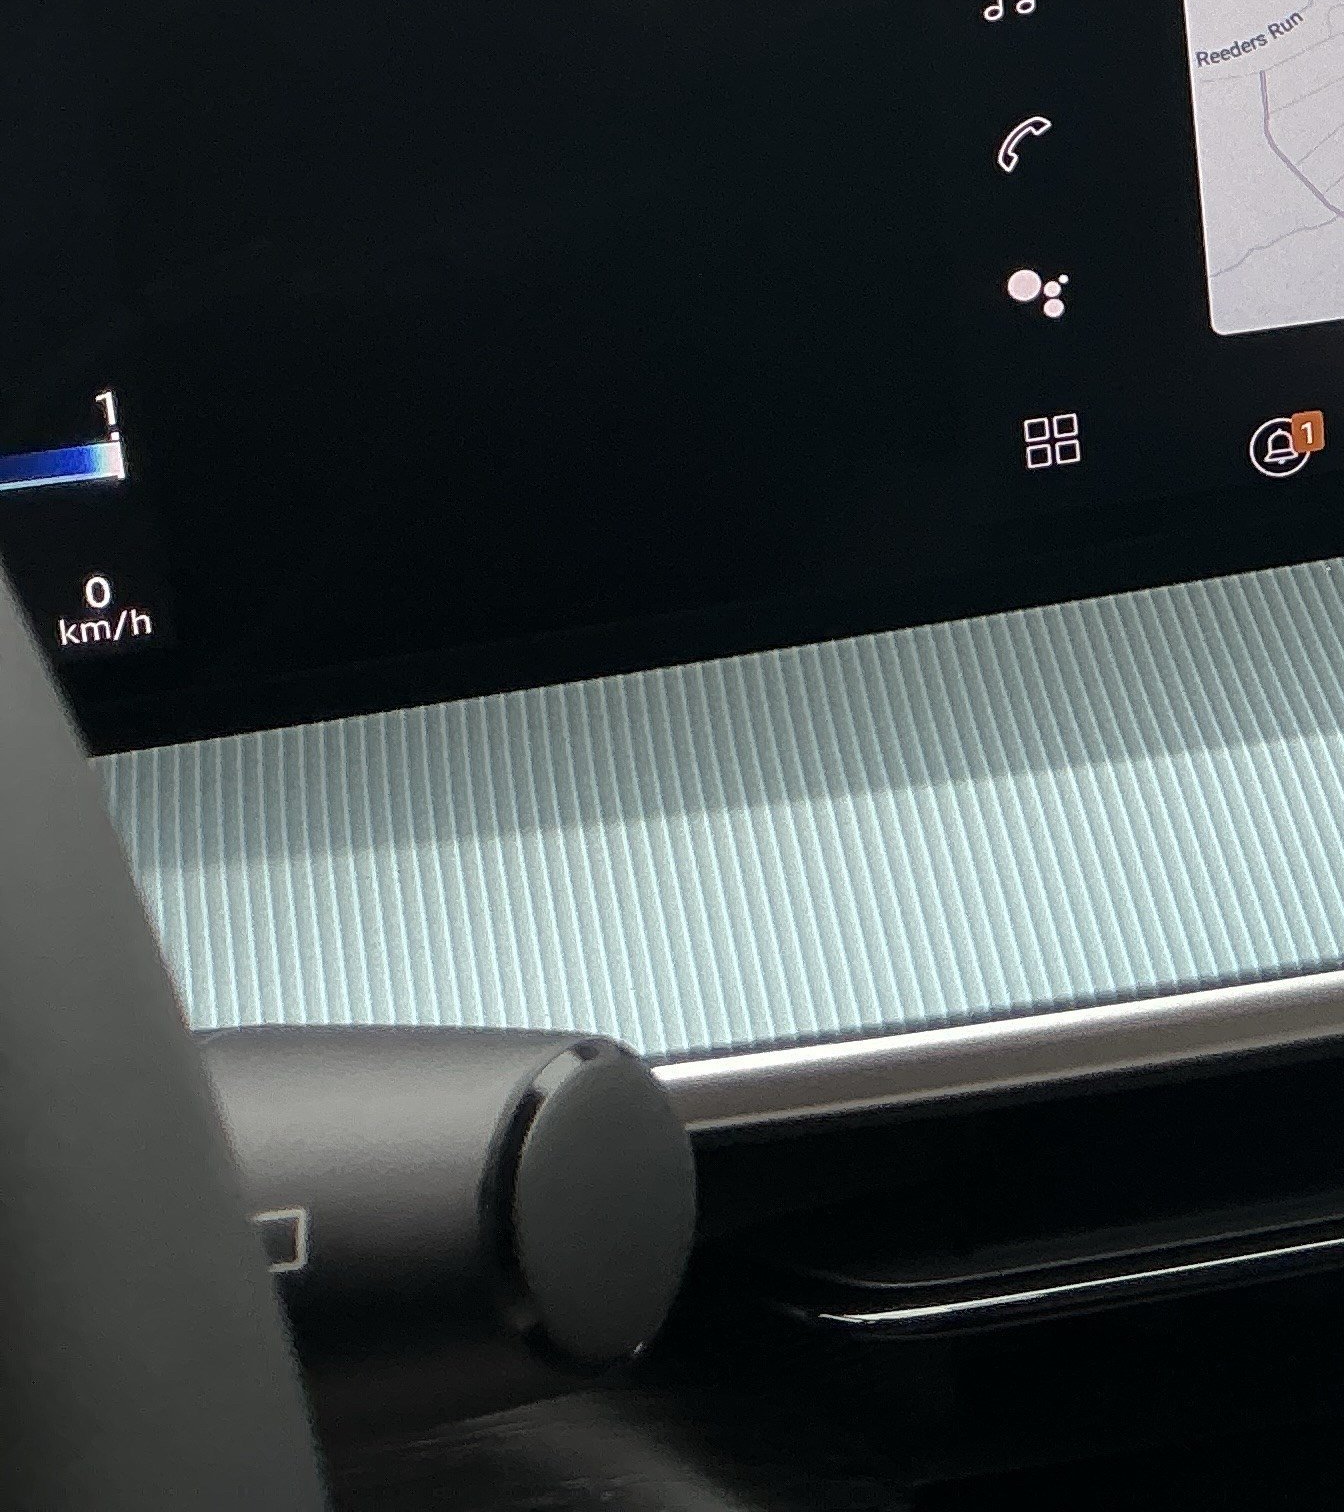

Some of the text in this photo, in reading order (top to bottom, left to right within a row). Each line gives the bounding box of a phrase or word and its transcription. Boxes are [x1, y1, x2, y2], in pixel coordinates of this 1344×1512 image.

[1195, 11, 1304, 68] Reeders Run
[1300, 421, 1313, 445] 1
[85, 575, 112, 609] 0
[58, 609, 152, 646] km/h
